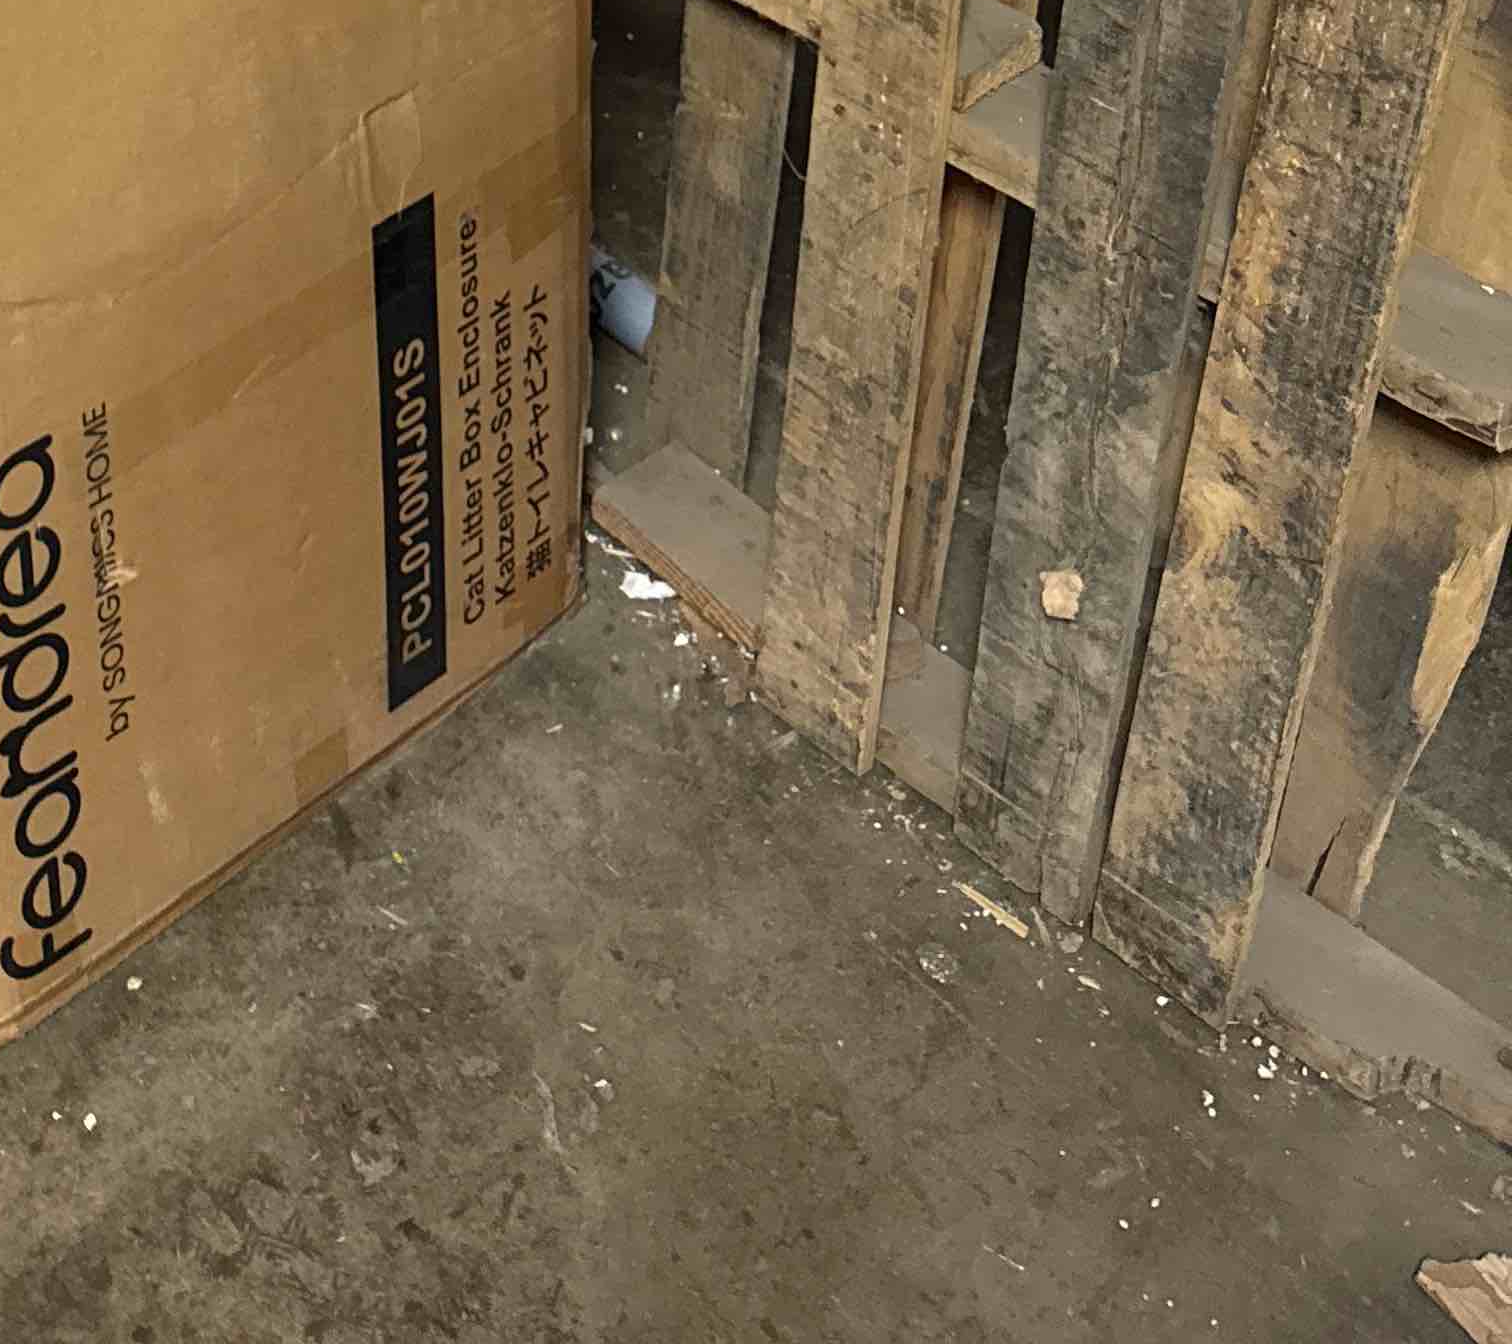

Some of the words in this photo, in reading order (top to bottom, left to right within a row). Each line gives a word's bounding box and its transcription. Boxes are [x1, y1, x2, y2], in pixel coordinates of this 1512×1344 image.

[457, 212, 482, 397] Enclosure
[81, 402, 114, 506] HOME
[459, 401, 483, 473] Box
[489, 288, 516, 606] Katzenklo-Schrank
[394, 336, 434, 664] PCL010WJ01S
[462, 475, 486, 558] Litter
[88, 508, 131, 692] SONGMICS
[462, 563, 486, 626] Cat
[104, 695, 137, 743] by
